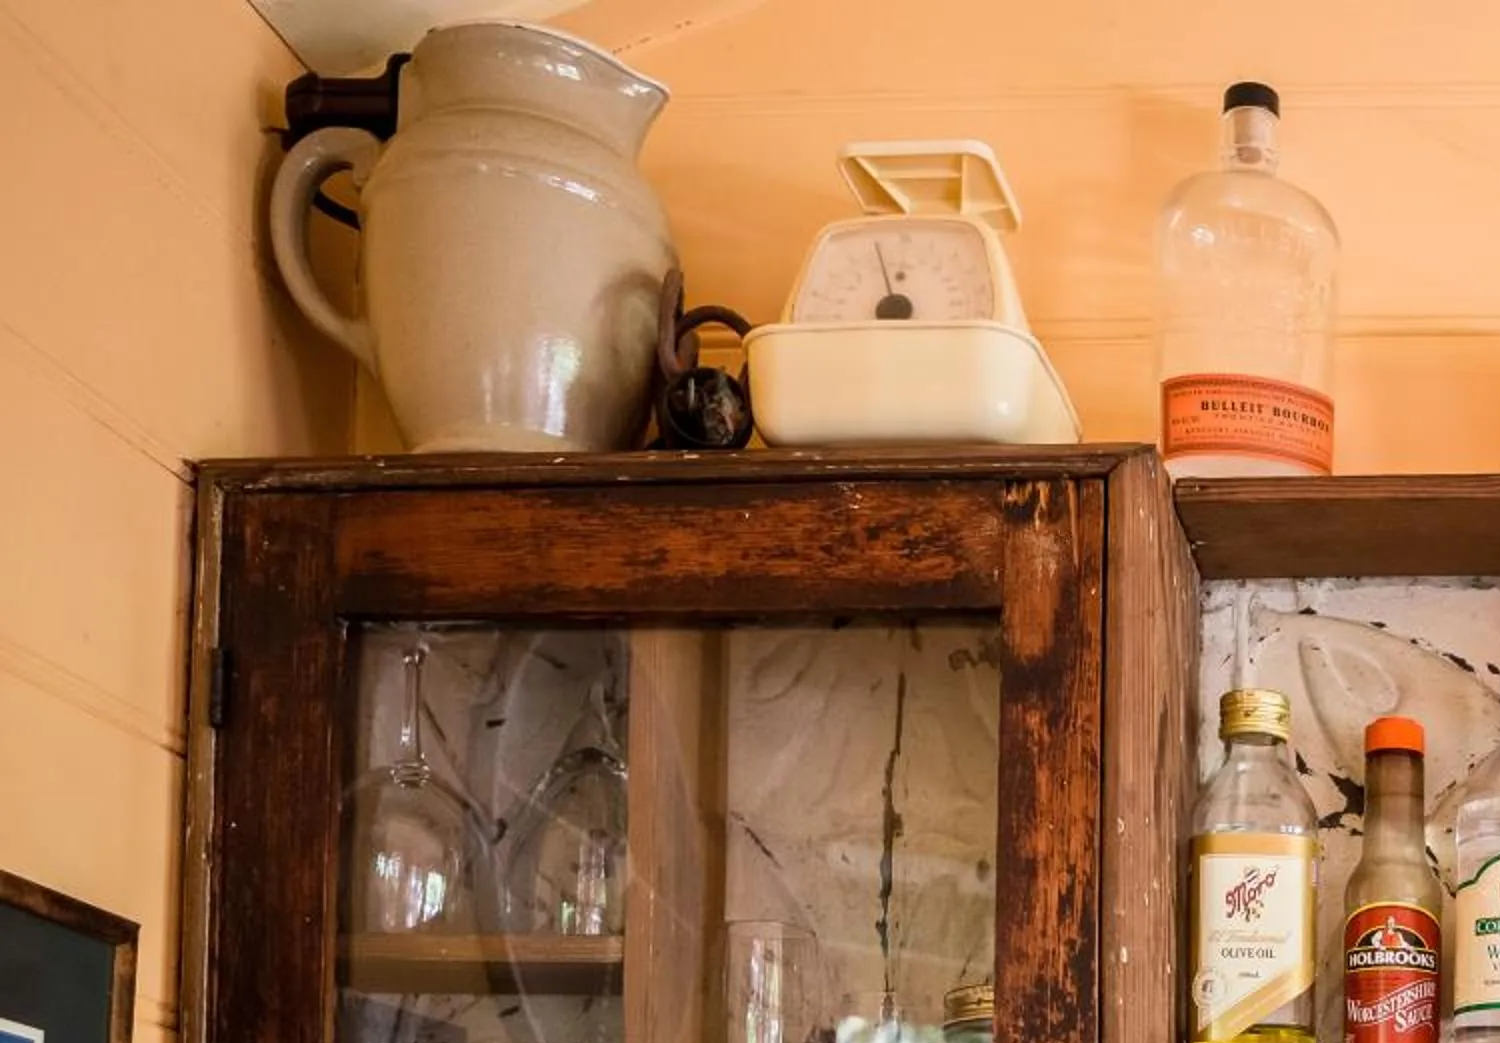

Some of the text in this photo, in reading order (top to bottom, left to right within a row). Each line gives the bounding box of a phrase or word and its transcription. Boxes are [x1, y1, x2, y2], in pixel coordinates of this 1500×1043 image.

[1200, 400, 1264, 414] BULLEIT
[1220, 948, 1276, 959] OLIVE OIL
[1349, 951, 1435, 969] HOLBROOKS
